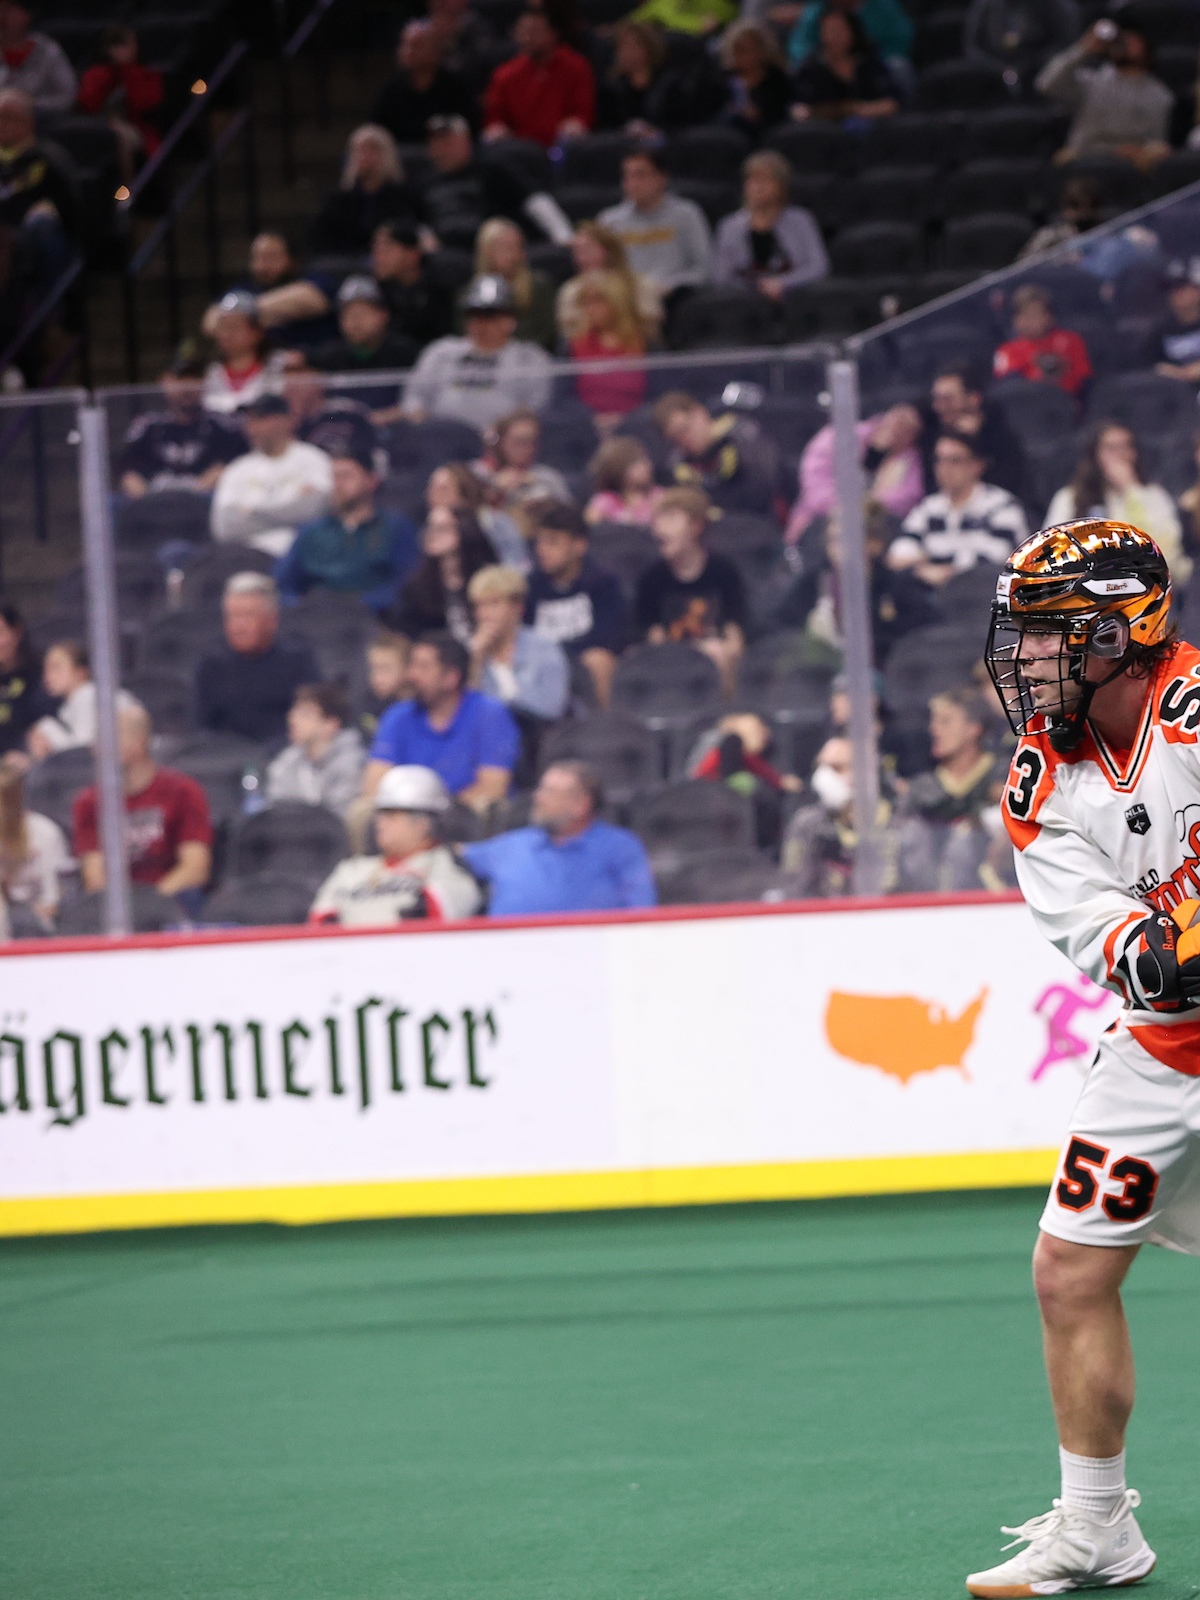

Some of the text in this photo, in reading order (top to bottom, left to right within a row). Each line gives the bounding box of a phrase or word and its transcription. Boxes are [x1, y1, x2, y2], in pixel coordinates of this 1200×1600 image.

[1074, 522, 1105, 534] BUFFALO
[1007, 743, 1047, 821] 3
[1125, 802, 1145, 820] NLL
[1056, 1134, 1160, 1223] 53
